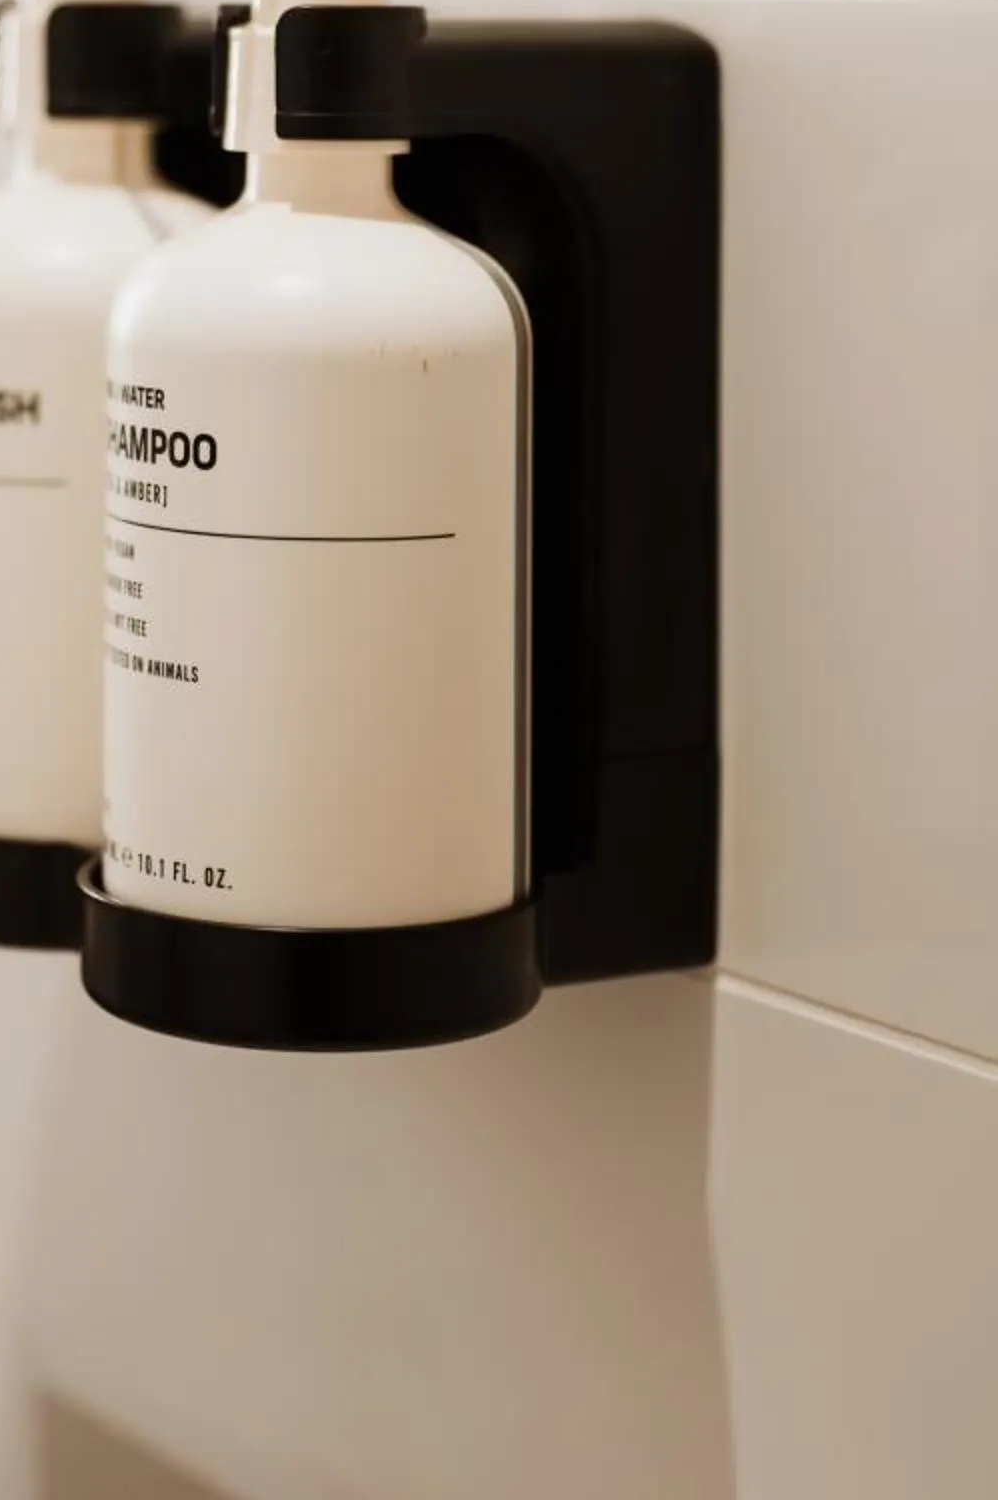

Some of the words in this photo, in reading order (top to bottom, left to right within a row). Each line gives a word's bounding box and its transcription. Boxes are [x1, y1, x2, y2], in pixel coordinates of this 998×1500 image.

[120, 384, 165, 410] WATER
[148, 659, 199, 684] ANIMALS
[138, 852, 165, 880] 10.1
[173, 860, 195, 885] FL.
[204, 866, 233, 890] OZ.
